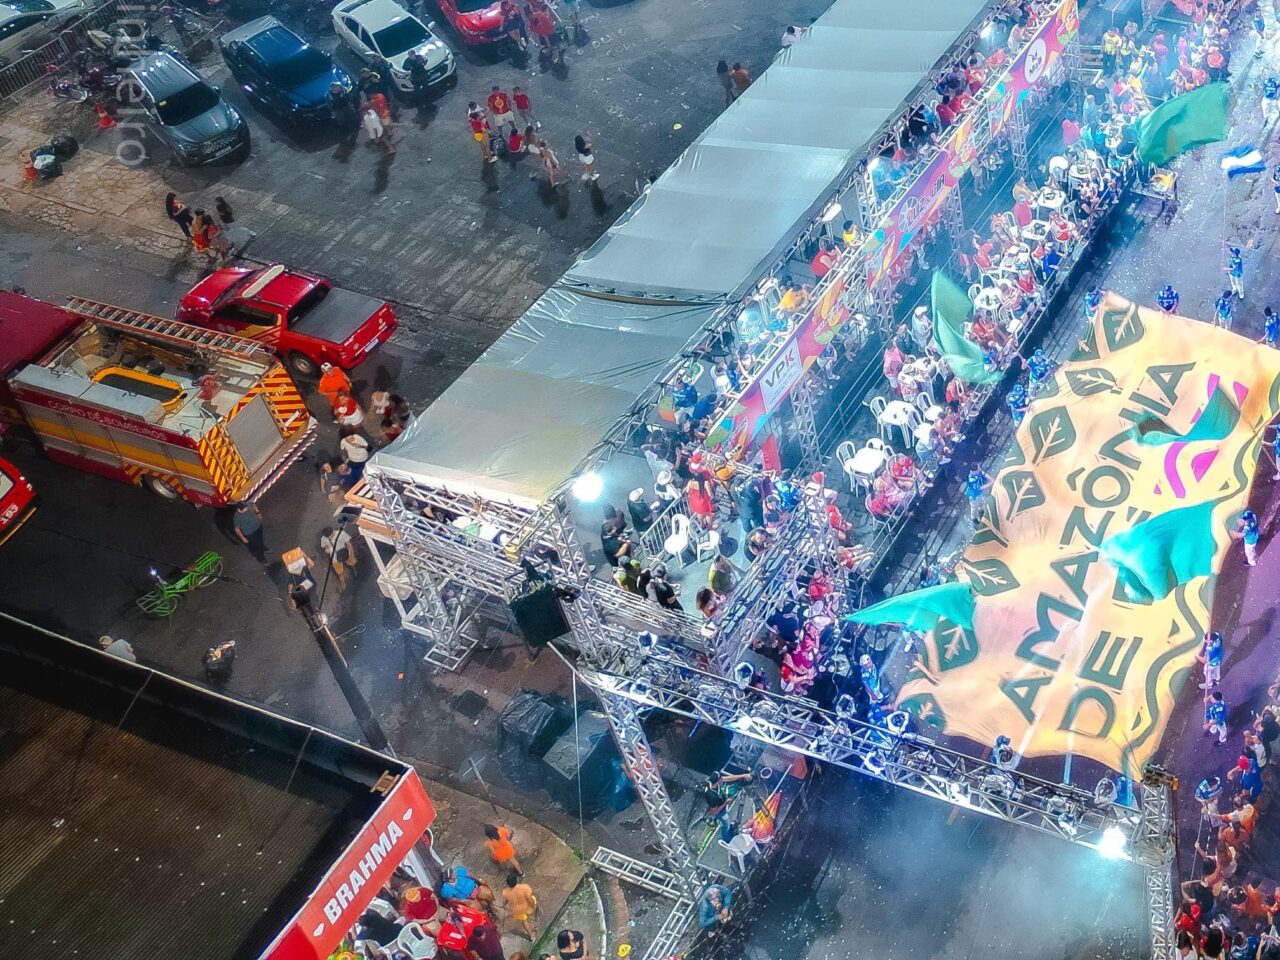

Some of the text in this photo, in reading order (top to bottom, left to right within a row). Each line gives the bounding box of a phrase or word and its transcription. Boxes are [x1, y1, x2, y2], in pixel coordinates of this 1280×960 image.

[765, 348, 795, 387] VPK
[47, 400, 87, 416] CORPO
[103, 418, 168, 441] BOMBEIROS
[1057, 631, 1143, 739] DE
[323, 820, 404, 925] BRAHMA
